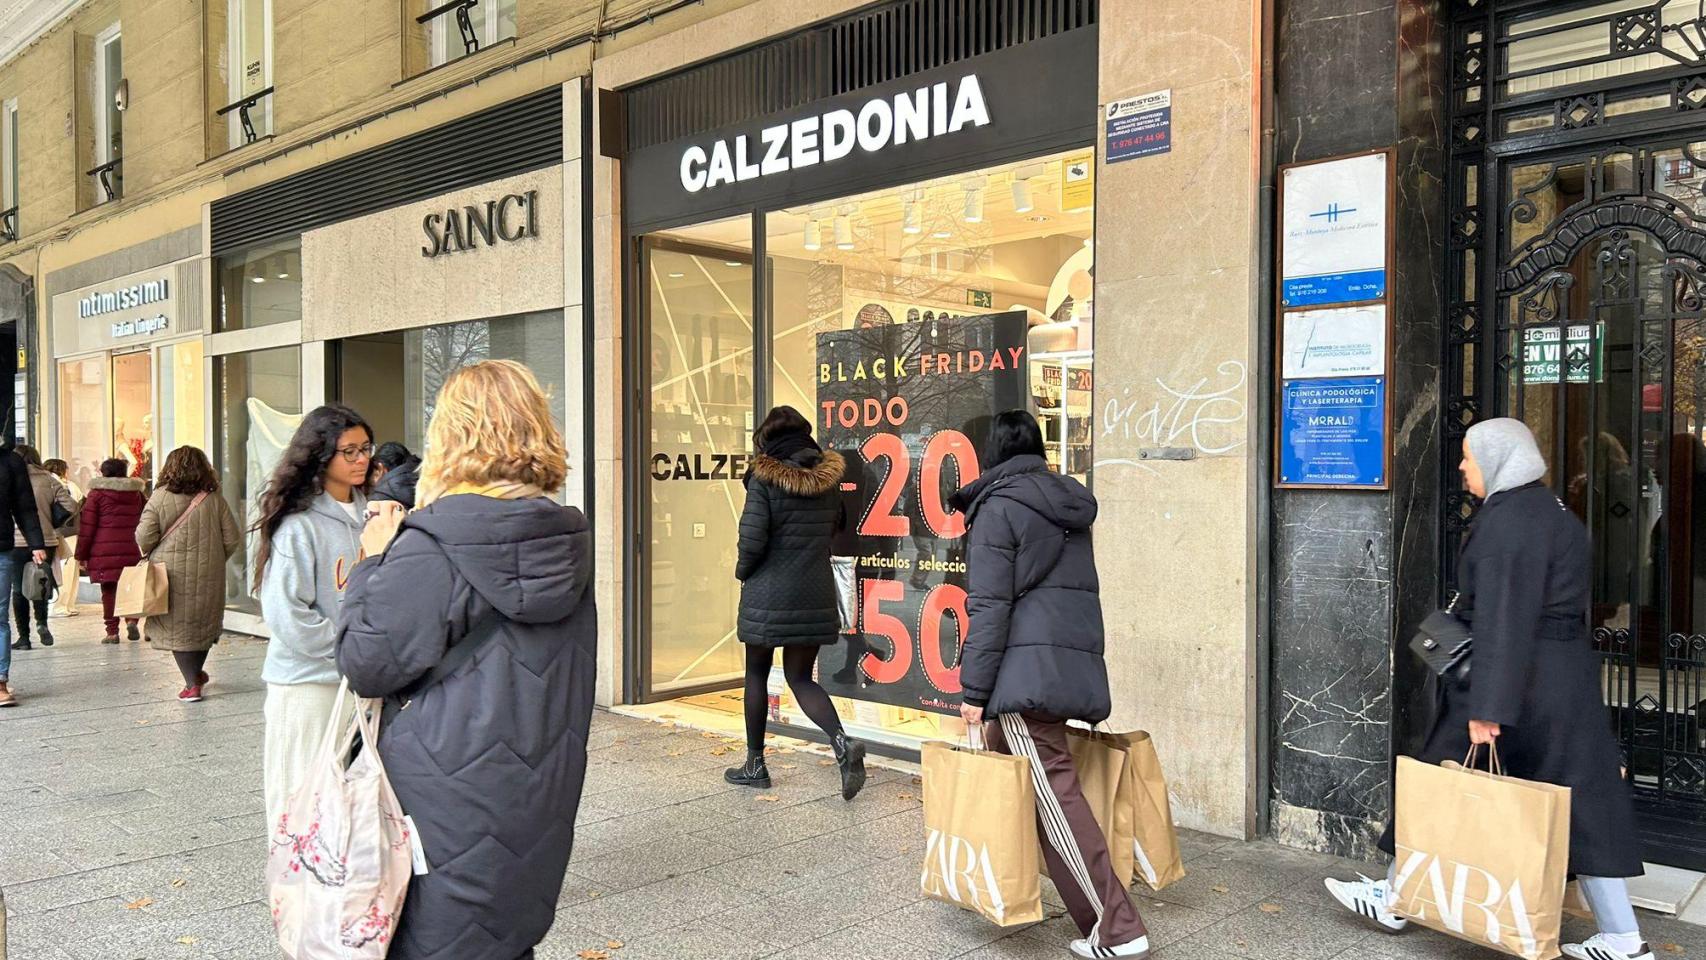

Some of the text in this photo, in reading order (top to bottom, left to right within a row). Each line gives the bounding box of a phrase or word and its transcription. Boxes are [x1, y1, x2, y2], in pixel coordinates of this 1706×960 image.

[680, 73, 992, 193] CALZEDONIA
[421, 189, 538, 258] SANCI
[820, 346, 1024, 384] BLACK FRIDAY
[1523, 364, 1545, 375] 876
[821, 396, 909, 429] TODO
[650, 452, 753, 481] CALZE
[860, 551, 911, 569] artículos
[918, 554, 967, 573] seleccio
[920, 825, 1004, 922] ZARA
[1386, 844, 1537, 956] ZARA
